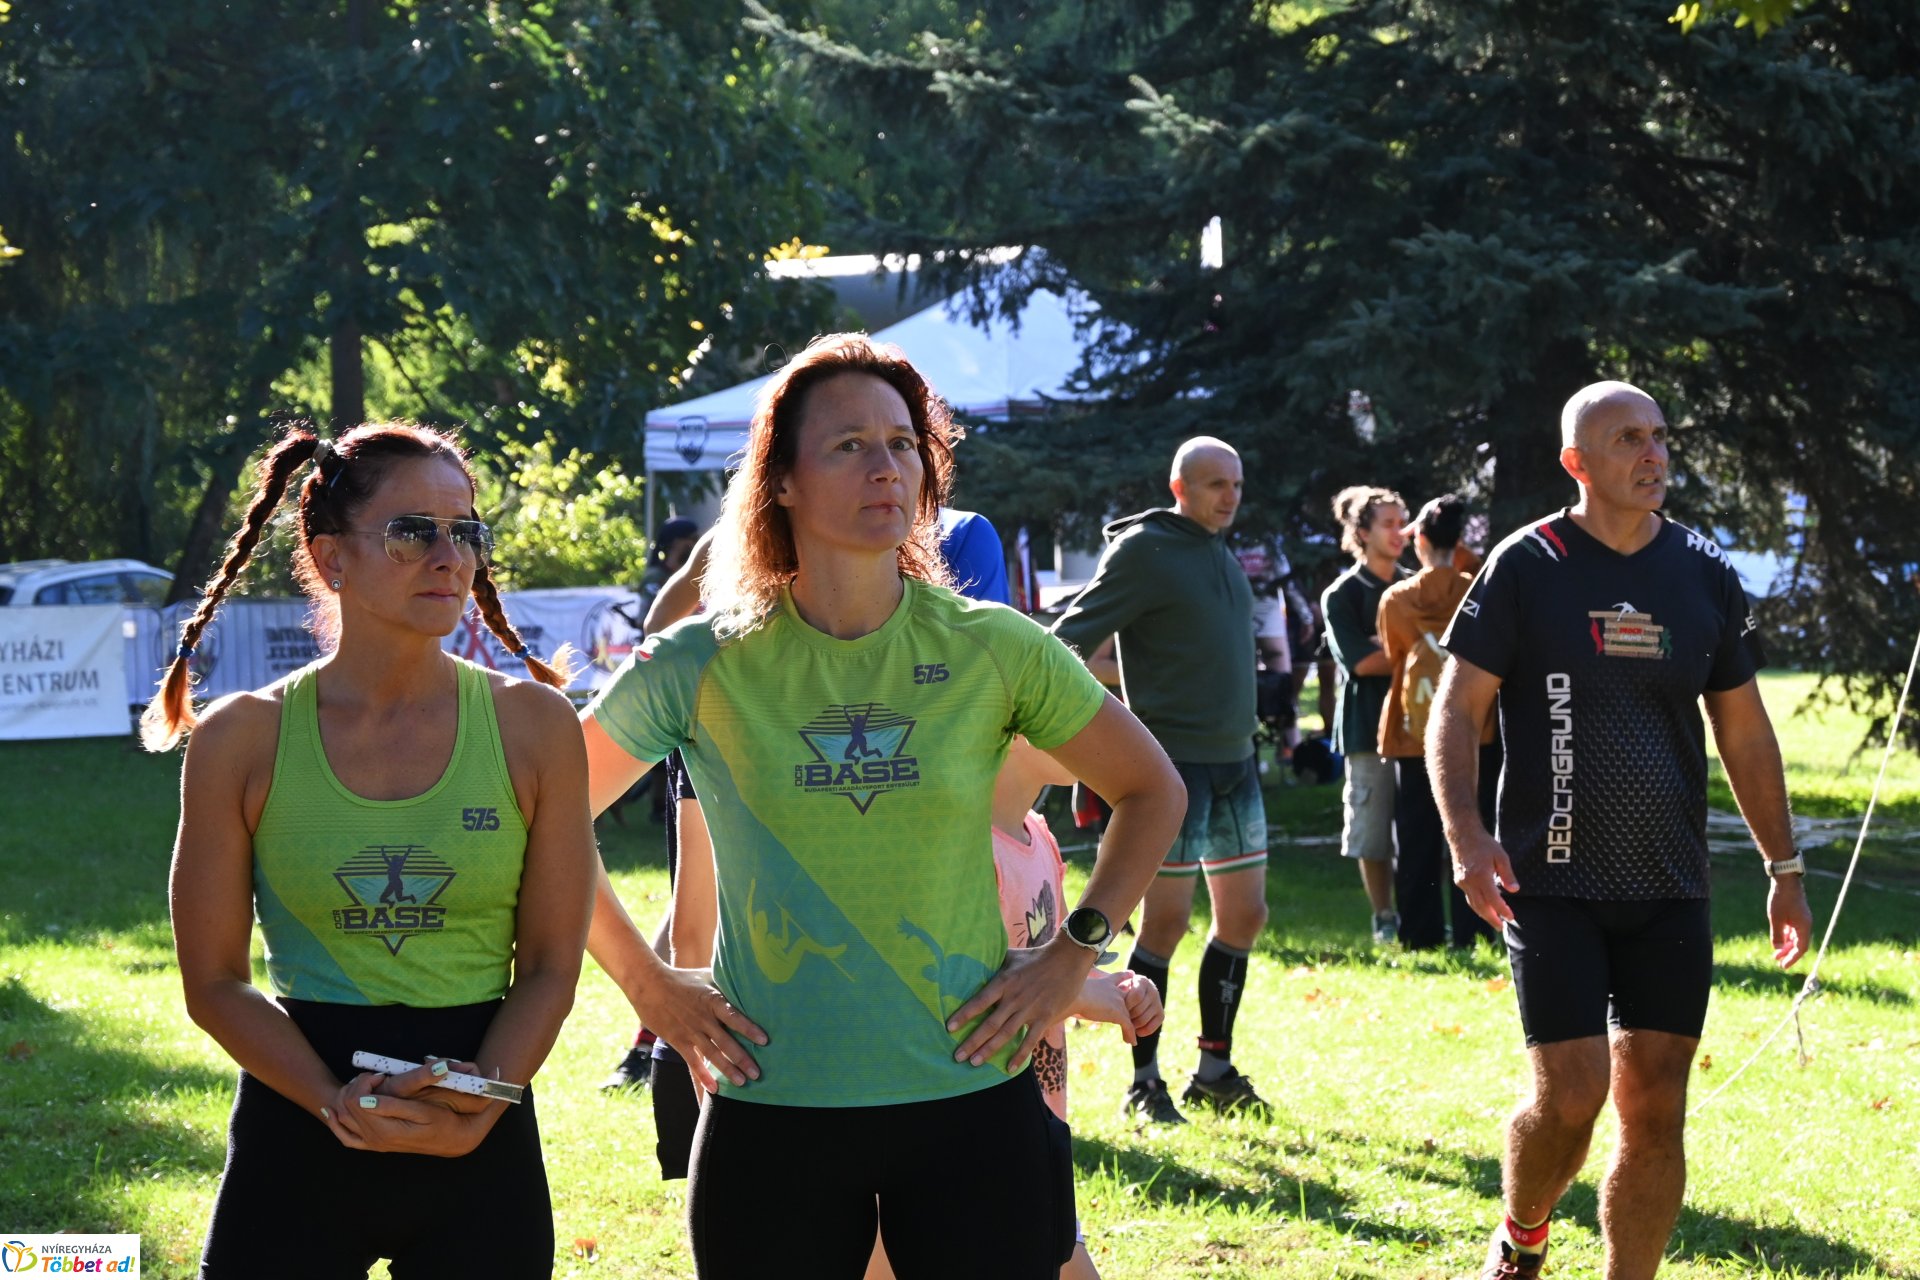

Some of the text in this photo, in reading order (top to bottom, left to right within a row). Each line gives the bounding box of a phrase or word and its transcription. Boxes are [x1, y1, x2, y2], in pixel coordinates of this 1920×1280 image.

[2, 669, 100, 696] ENTRUM
[914, 663, 950, 685] 575
[804, 757, 920, 787] BASE
[1546, 673, 1573, 863] DEOCRGRUND
[462, 808, 500, 831] 575
[342, 906, 447, 930] BASE
